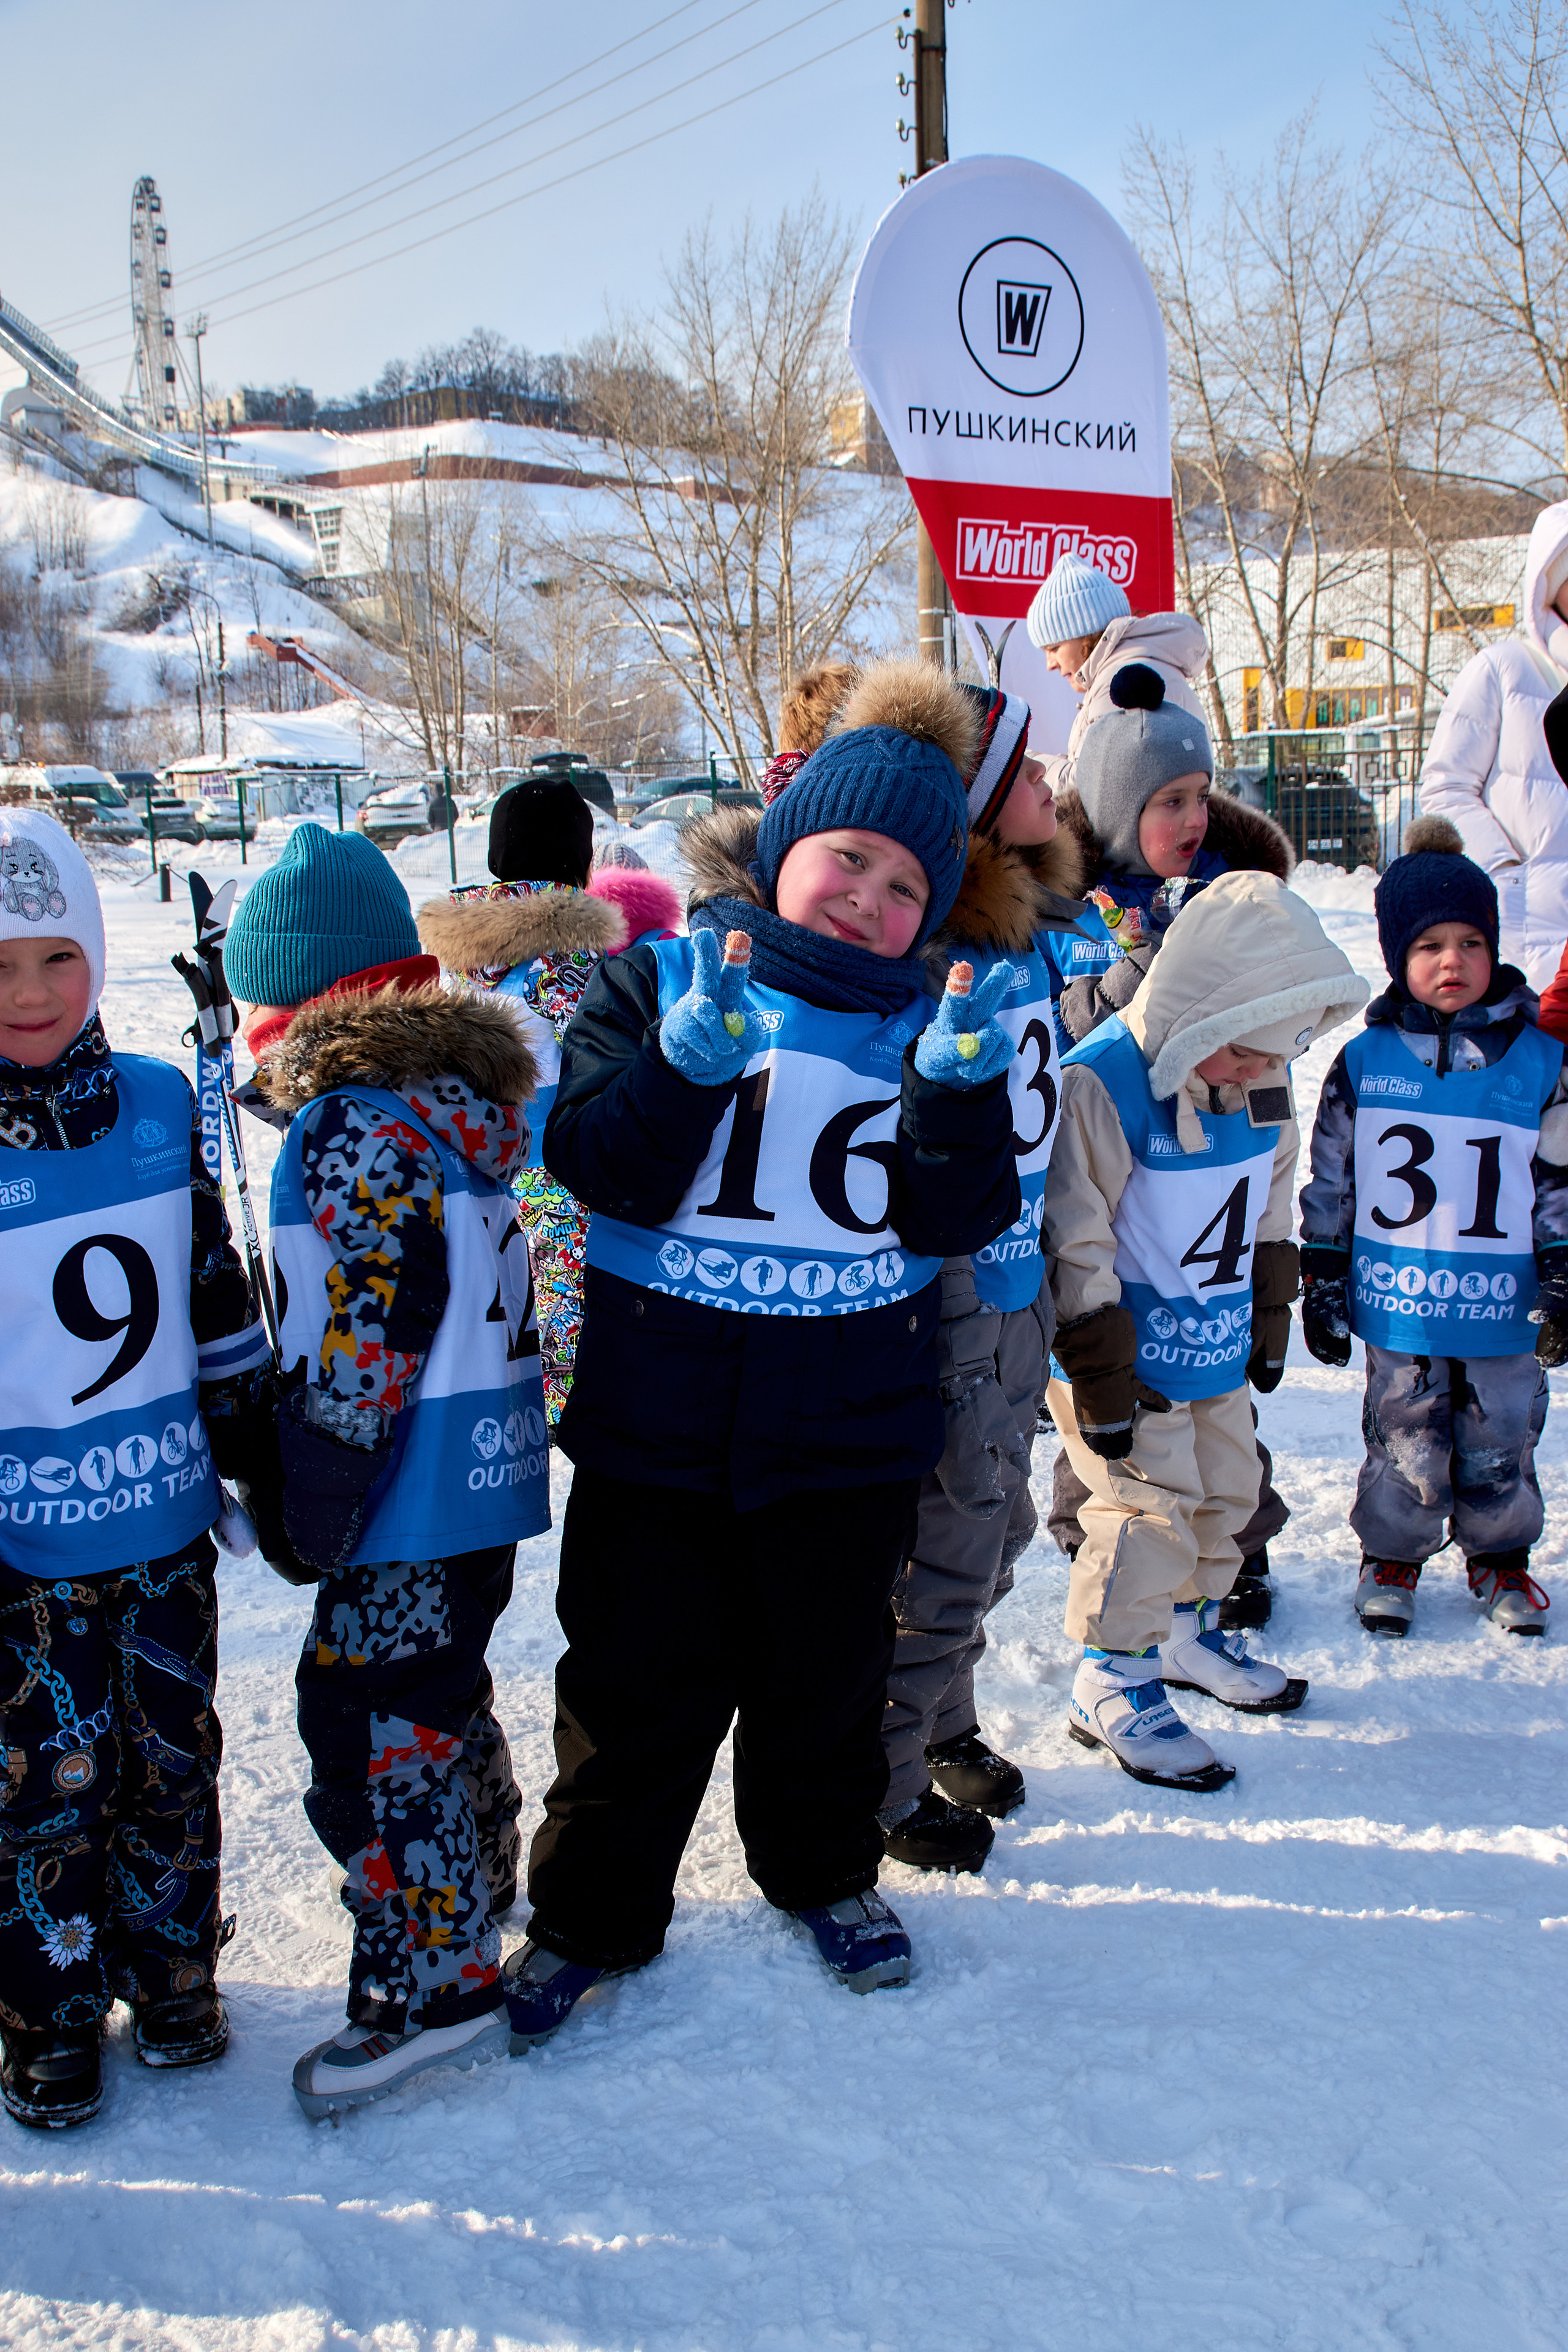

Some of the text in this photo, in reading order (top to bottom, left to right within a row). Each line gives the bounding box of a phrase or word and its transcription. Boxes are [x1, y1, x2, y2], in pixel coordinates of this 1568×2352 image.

[1005, 291, 1041, 346] W
[908, 405, 1137, 453] ПУШКИНСКИЙ
[964, 527, 1048, 576] World
[1074, 942, 1127, 961] World Cla
[870, 1041, 903, 1058] Пушки
[1388, 1078, 1420, 1096] Class
[130, 1144, 187, 1168] Пушкинский
[696, 1066, 902, 1235] 16
[0, 1181, 32, 1206] ass
[1371, 1123, 1509, 1239] 31
[241, 1196, 251, 1210] JR
[245, 1210, 254, 1232] ACTIVE
[541, 1221, 579, 1238] TOMAS
[1180, 1175, 1251, 1290] 4
[552, 1234, 570, 1244] ICE
[976, 1234, 1040, 1264] OUTD
[1355, 1287, 1516, 1321] OUTDOOR TEAM
[53, 1234, 159, 1407] 9
[468, 1450, 549, 1491] OUTDOOR
